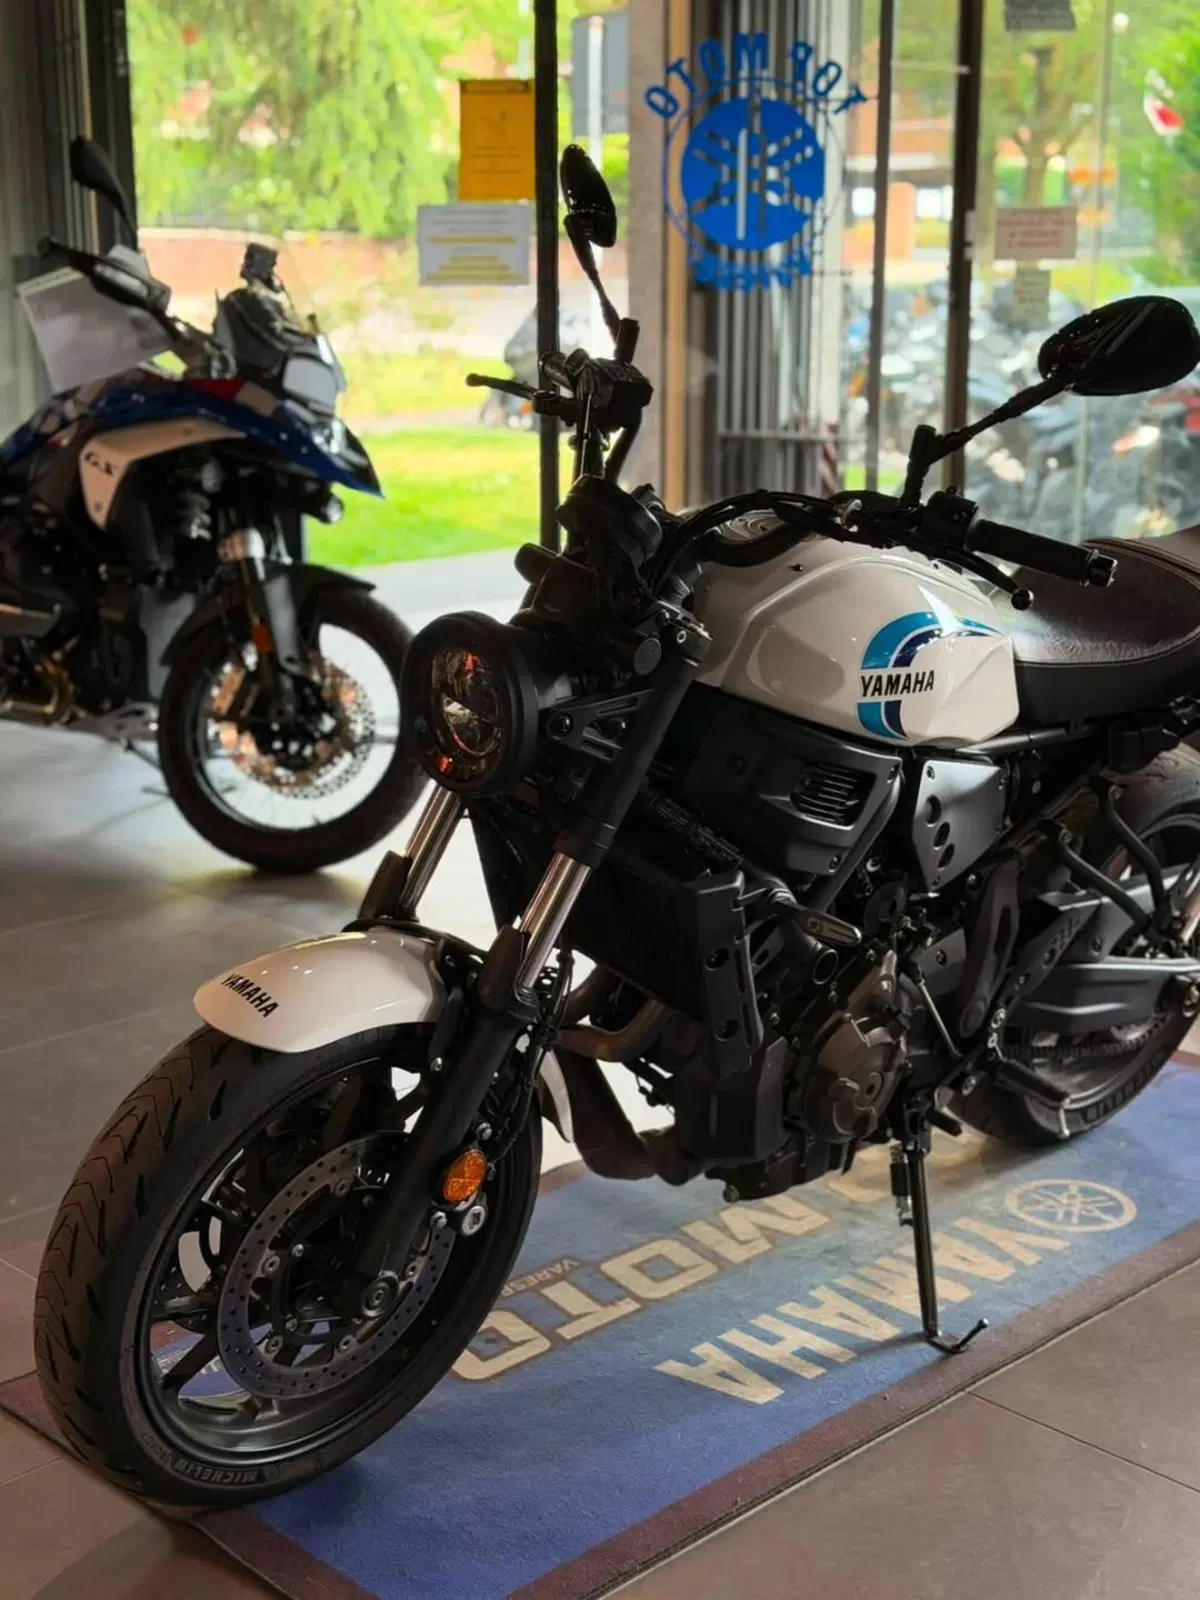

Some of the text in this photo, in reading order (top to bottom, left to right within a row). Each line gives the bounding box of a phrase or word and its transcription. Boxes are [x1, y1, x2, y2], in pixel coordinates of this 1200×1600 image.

[860, 670, 935, 697] YAMAHA
[221, 973, 279, 1018] YAMAHA
[654, 1217, 1070, 1405] YAMAHA
[173, 1457, 259, 1484] MICHELIN
